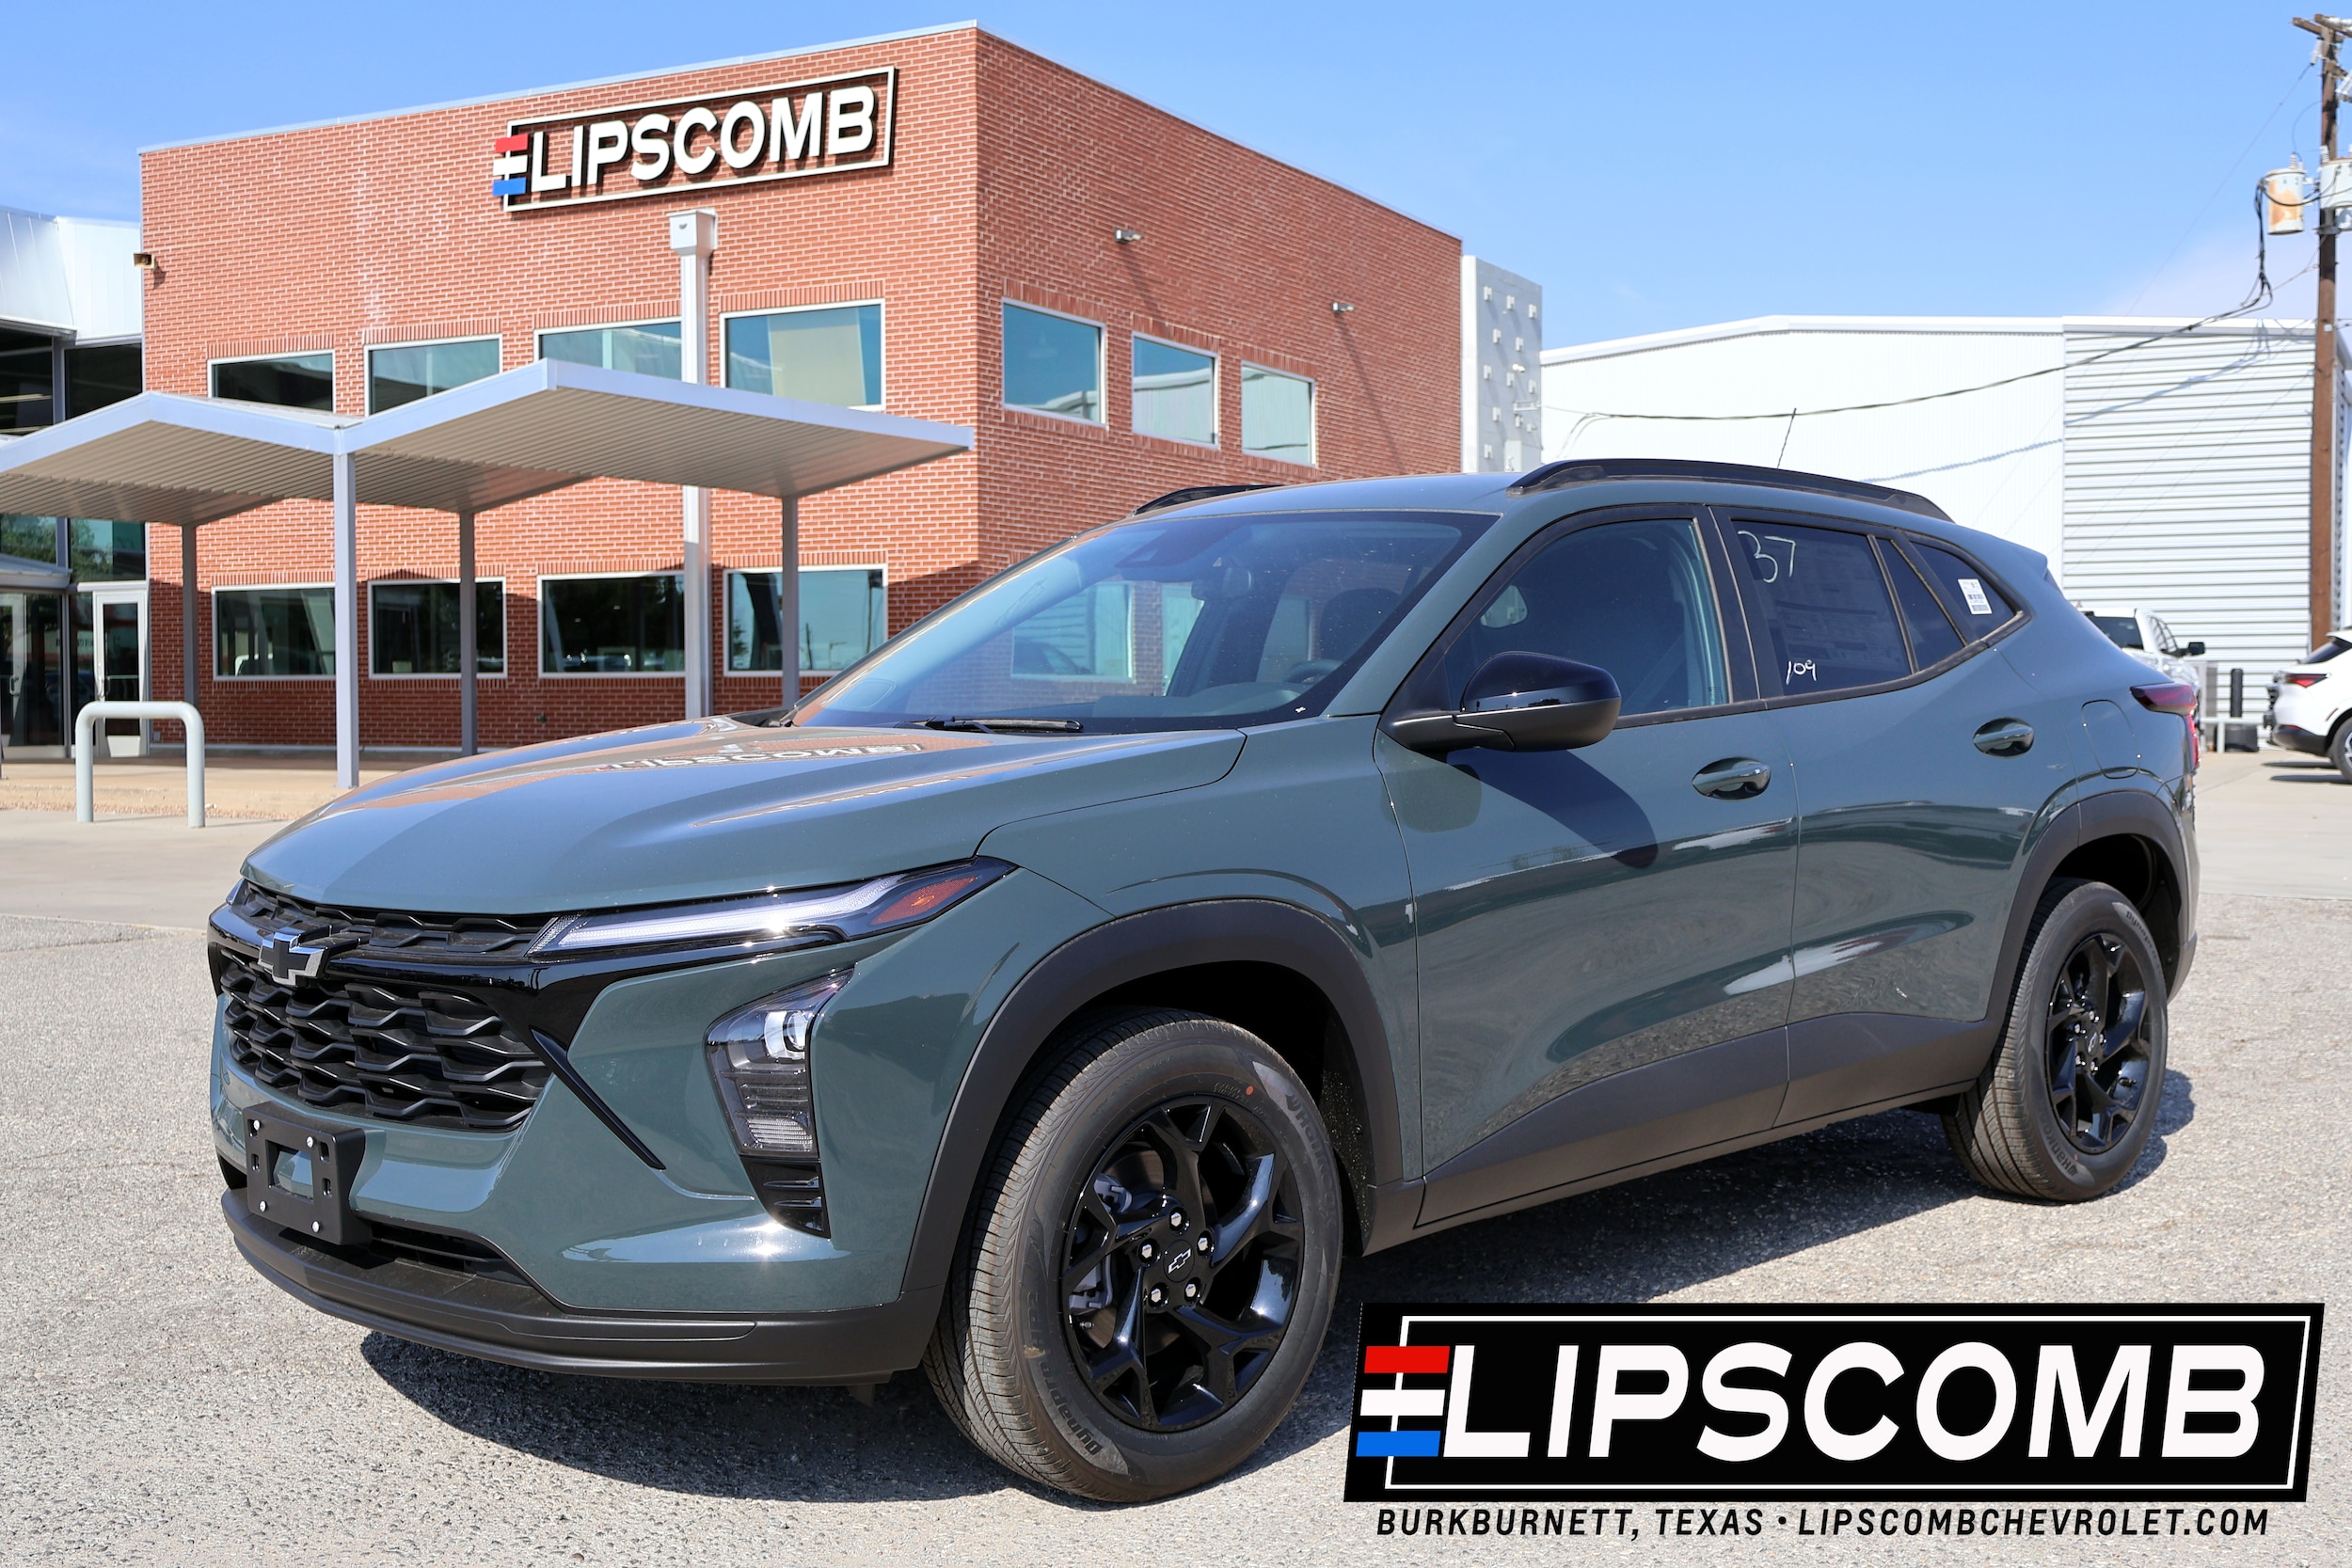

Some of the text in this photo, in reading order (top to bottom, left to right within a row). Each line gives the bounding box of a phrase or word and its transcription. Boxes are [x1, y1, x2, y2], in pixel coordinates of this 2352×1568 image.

[531, 85, 876, 193] LIPSCOMB
[1737, 530, 1797, 583] 37
[1785, 659, 1818, 686] 109
[1039, 1360, 1104, 1456] Dynapro
